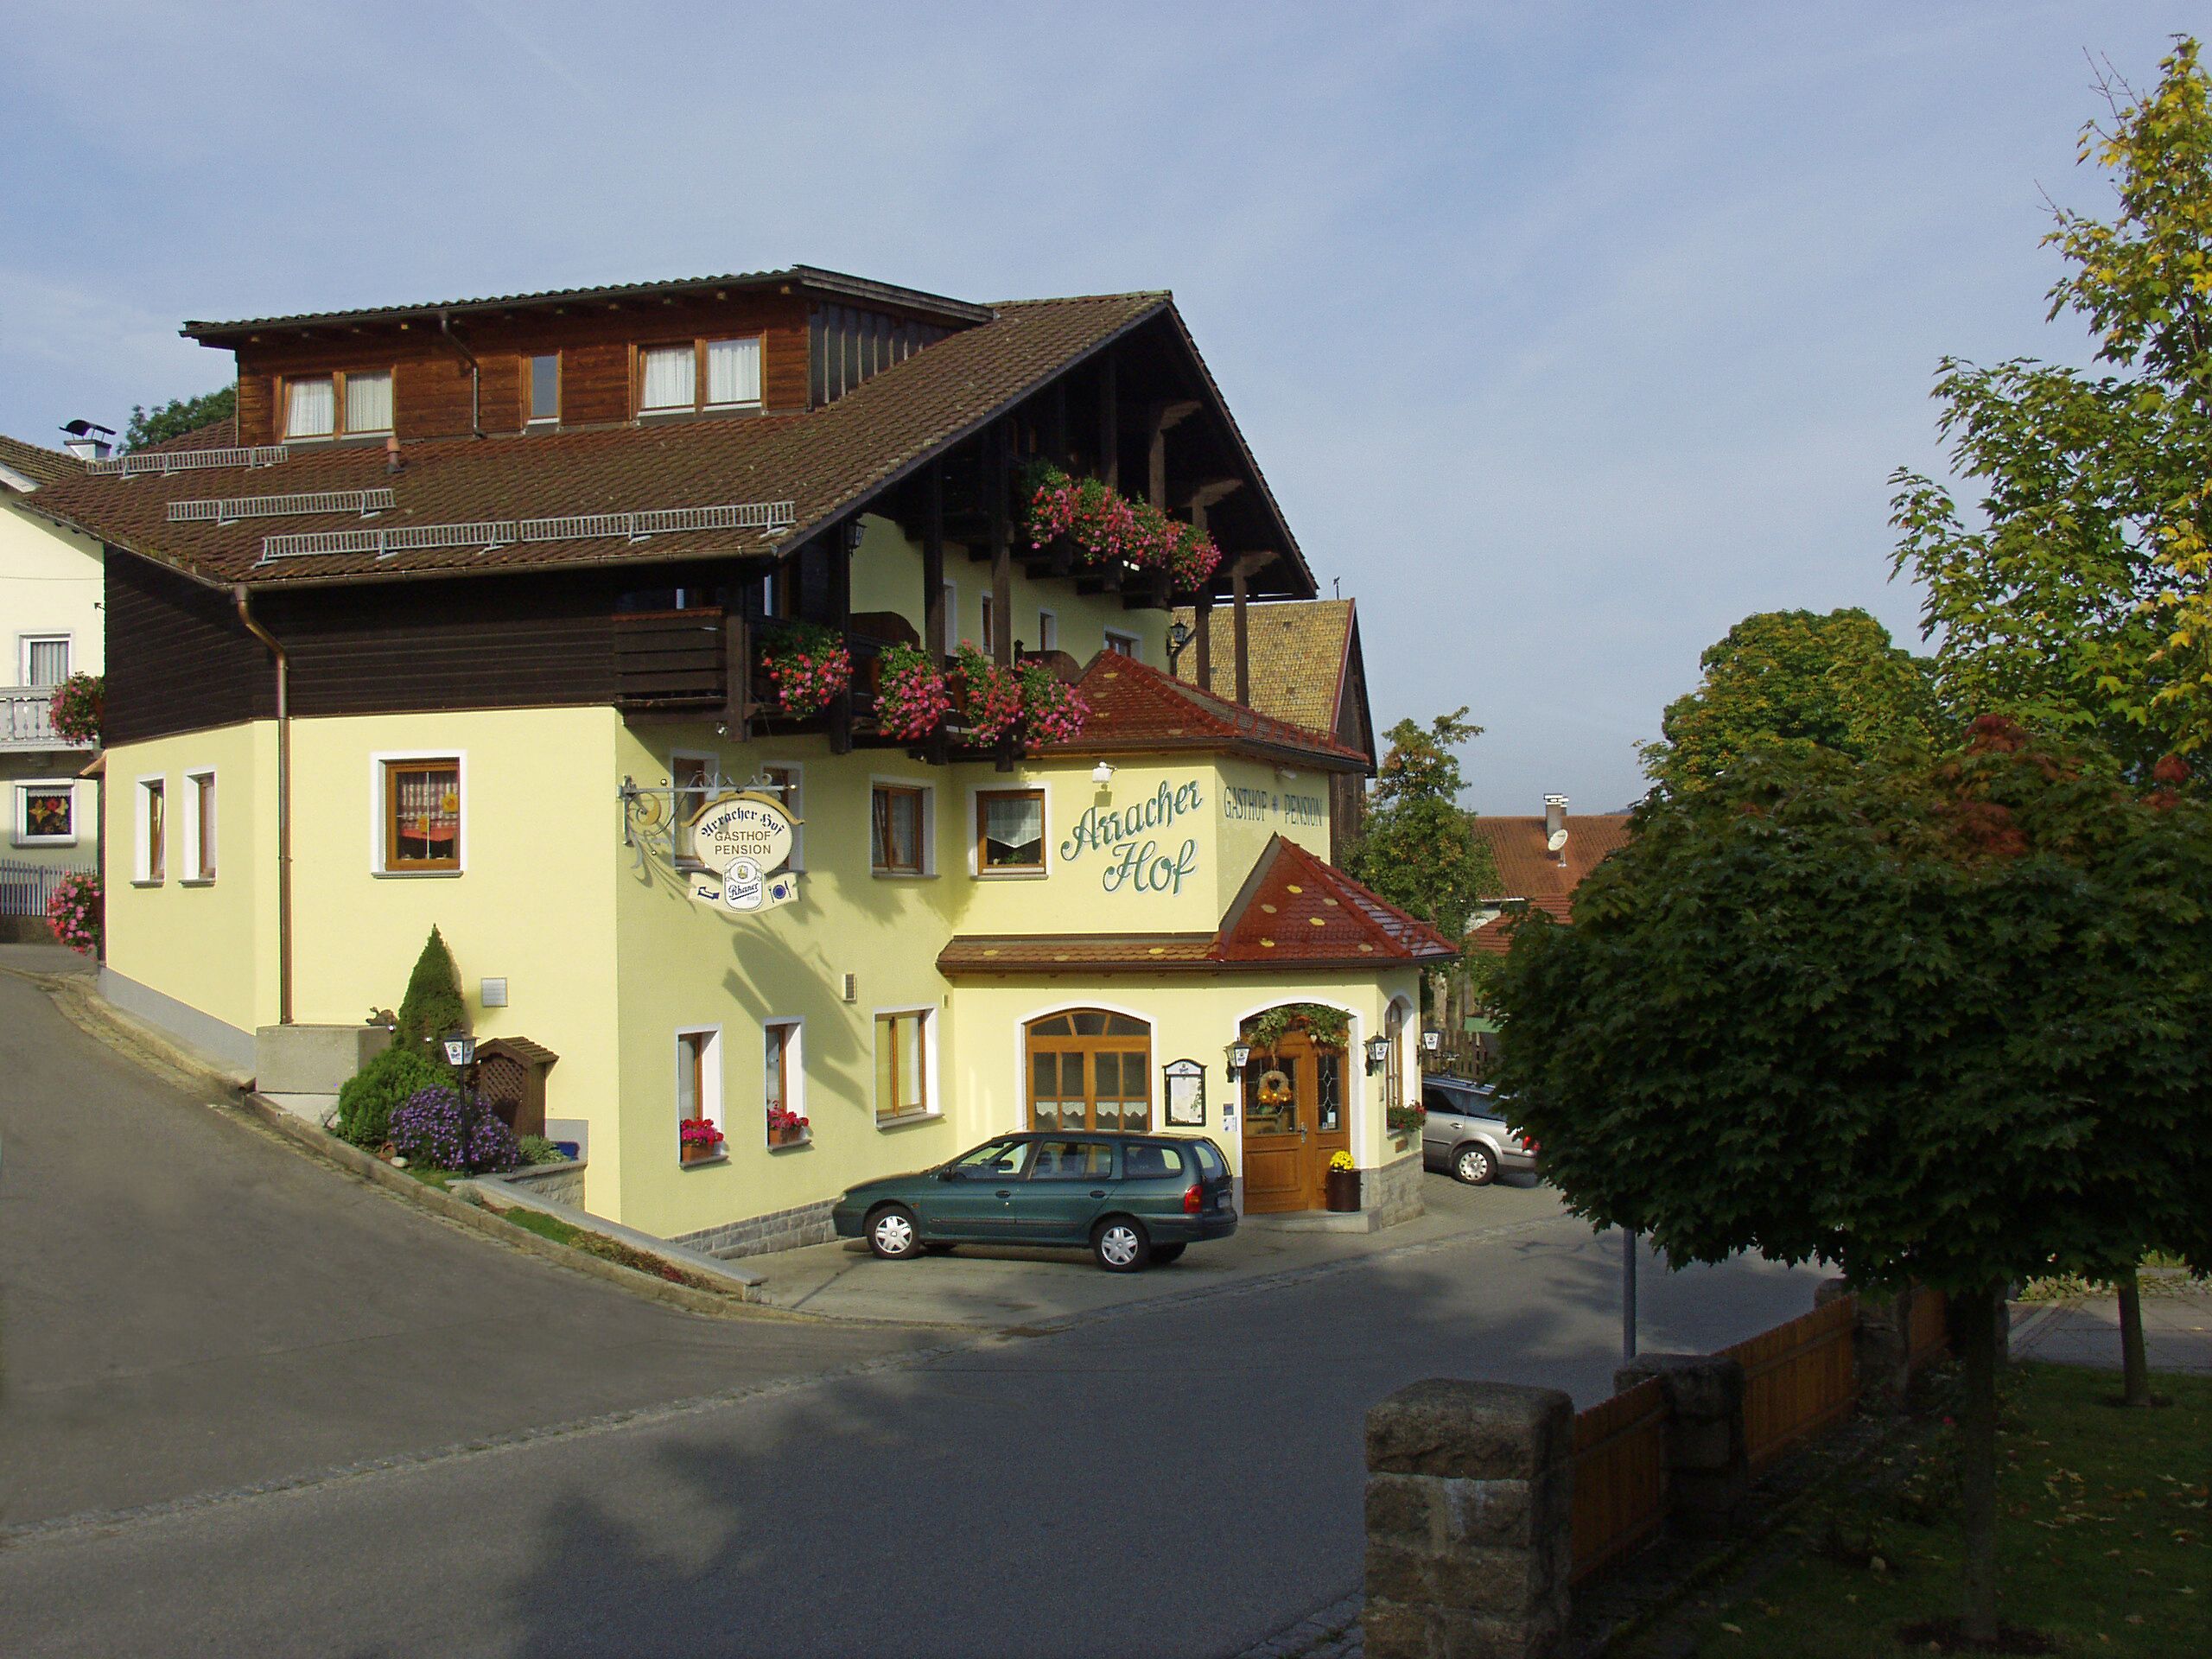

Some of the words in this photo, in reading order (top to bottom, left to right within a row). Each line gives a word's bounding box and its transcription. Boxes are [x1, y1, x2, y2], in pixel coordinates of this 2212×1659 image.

[701, 806, 758, 837] Arracher
[760, 813, 785, 836] Hof
[1060, 779, 1202, 861] Arracher
[1224, 786, 1267, 822] GASTHOF
[1284, 793, 1322, 827] PENSION
[714, 830, 771, 842] GASTHOF
[715, 844, 771, 855] PENSION
[1103, 839, 1196, 894] Hof
